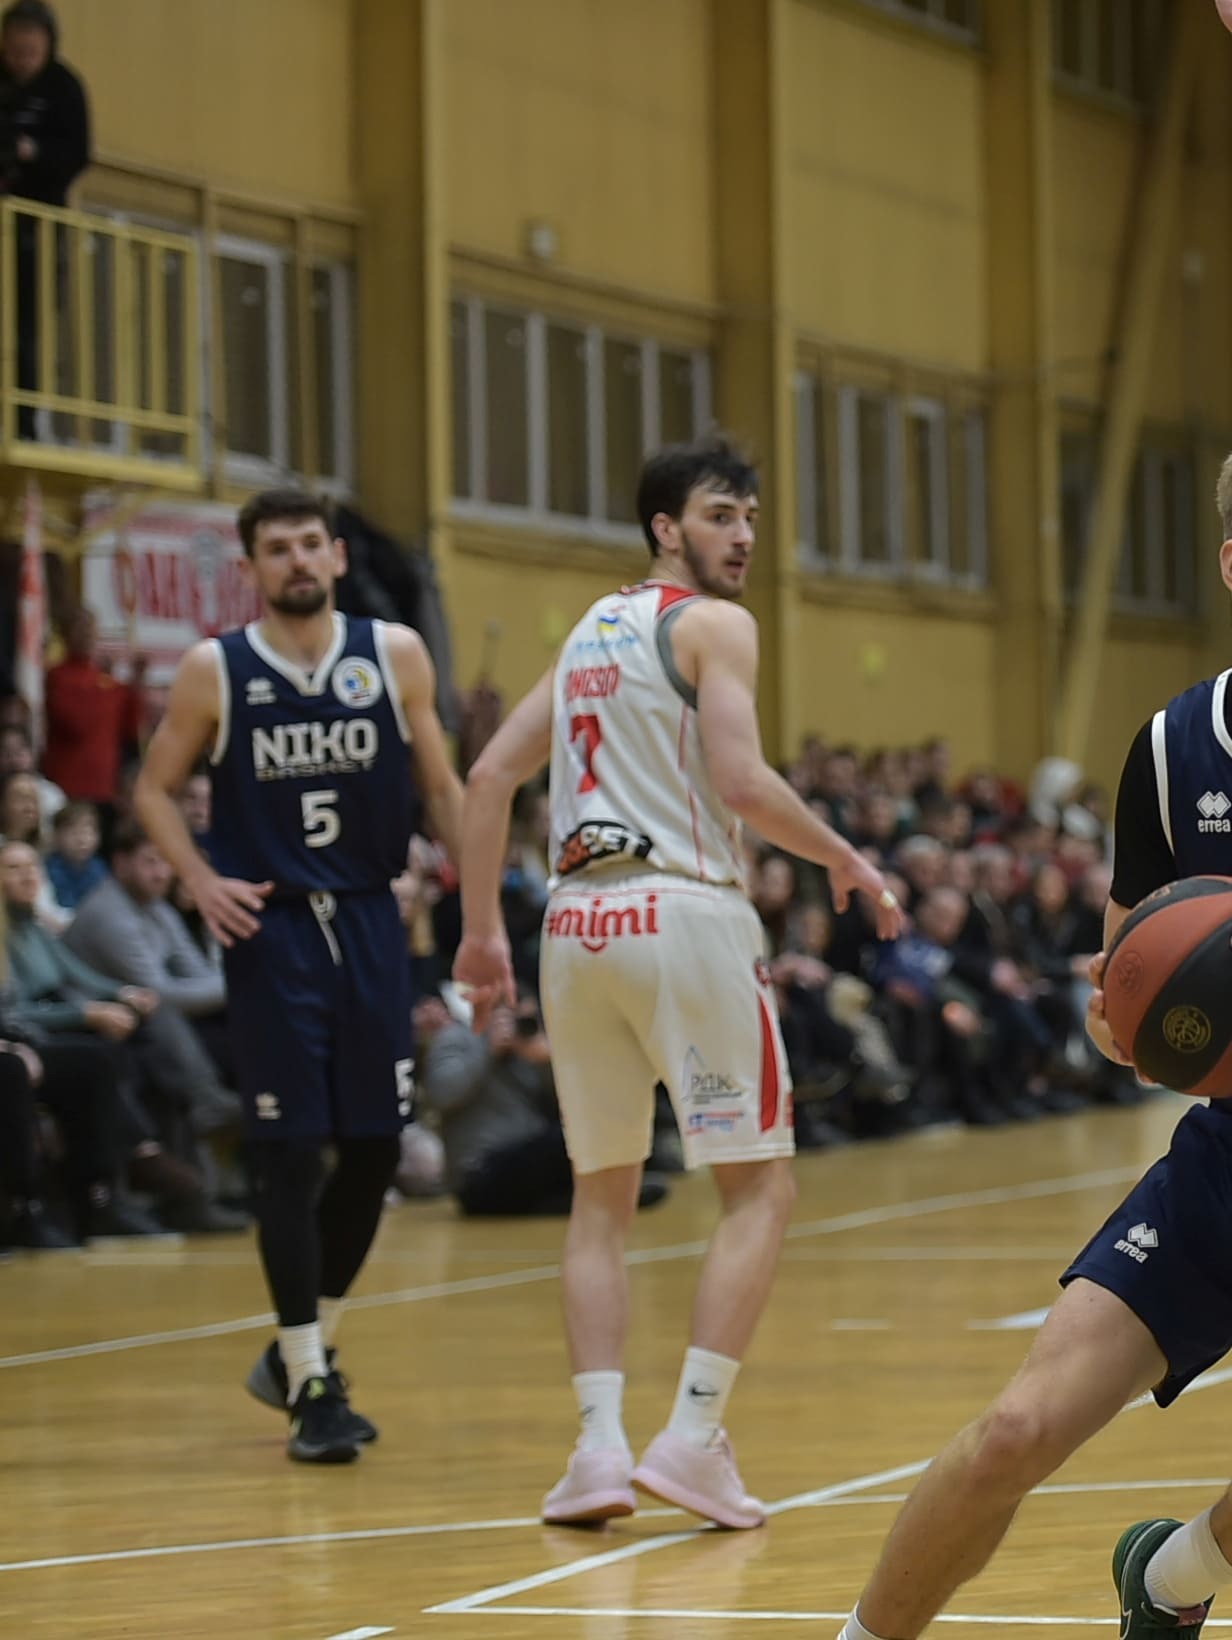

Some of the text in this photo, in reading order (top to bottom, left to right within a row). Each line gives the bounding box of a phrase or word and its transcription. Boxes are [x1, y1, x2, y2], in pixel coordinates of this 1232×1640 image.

[252, 718, 378, 768] NIKO
[570, 714, 602, 794] 7
[300, 790, 340, 848] 5
[1198, 819, 1231, 833] errea
[1114, 1239, 1149, 1263] errea
